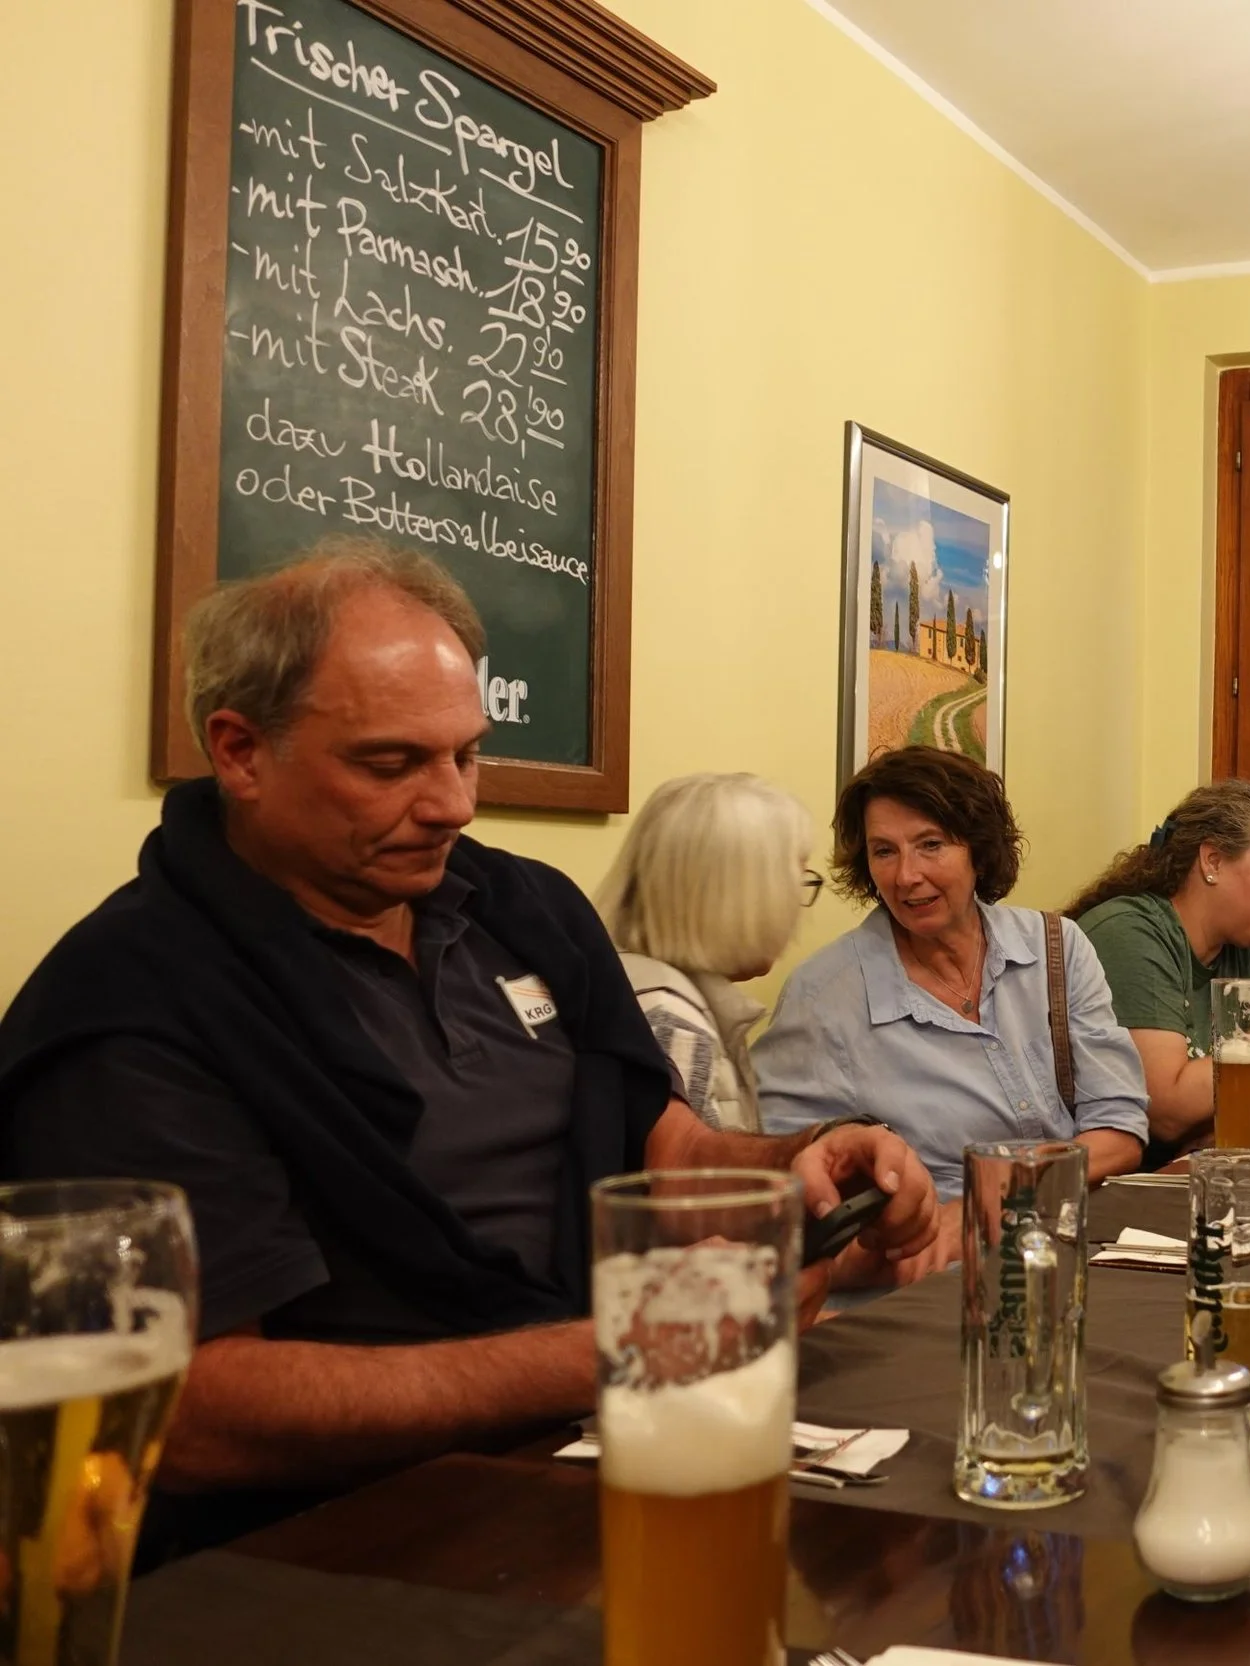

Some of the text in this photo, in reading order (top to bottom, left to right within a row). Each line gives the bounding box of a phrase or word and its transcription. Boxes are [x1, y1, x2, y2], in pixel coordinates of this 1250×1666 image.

[414, 70, 574, 191] Spargel
[236, 463, 337, 515] oder
[246, 397, 558, 516] dazu Hollandaise
[525, 1003, 552, 1020] KRG
